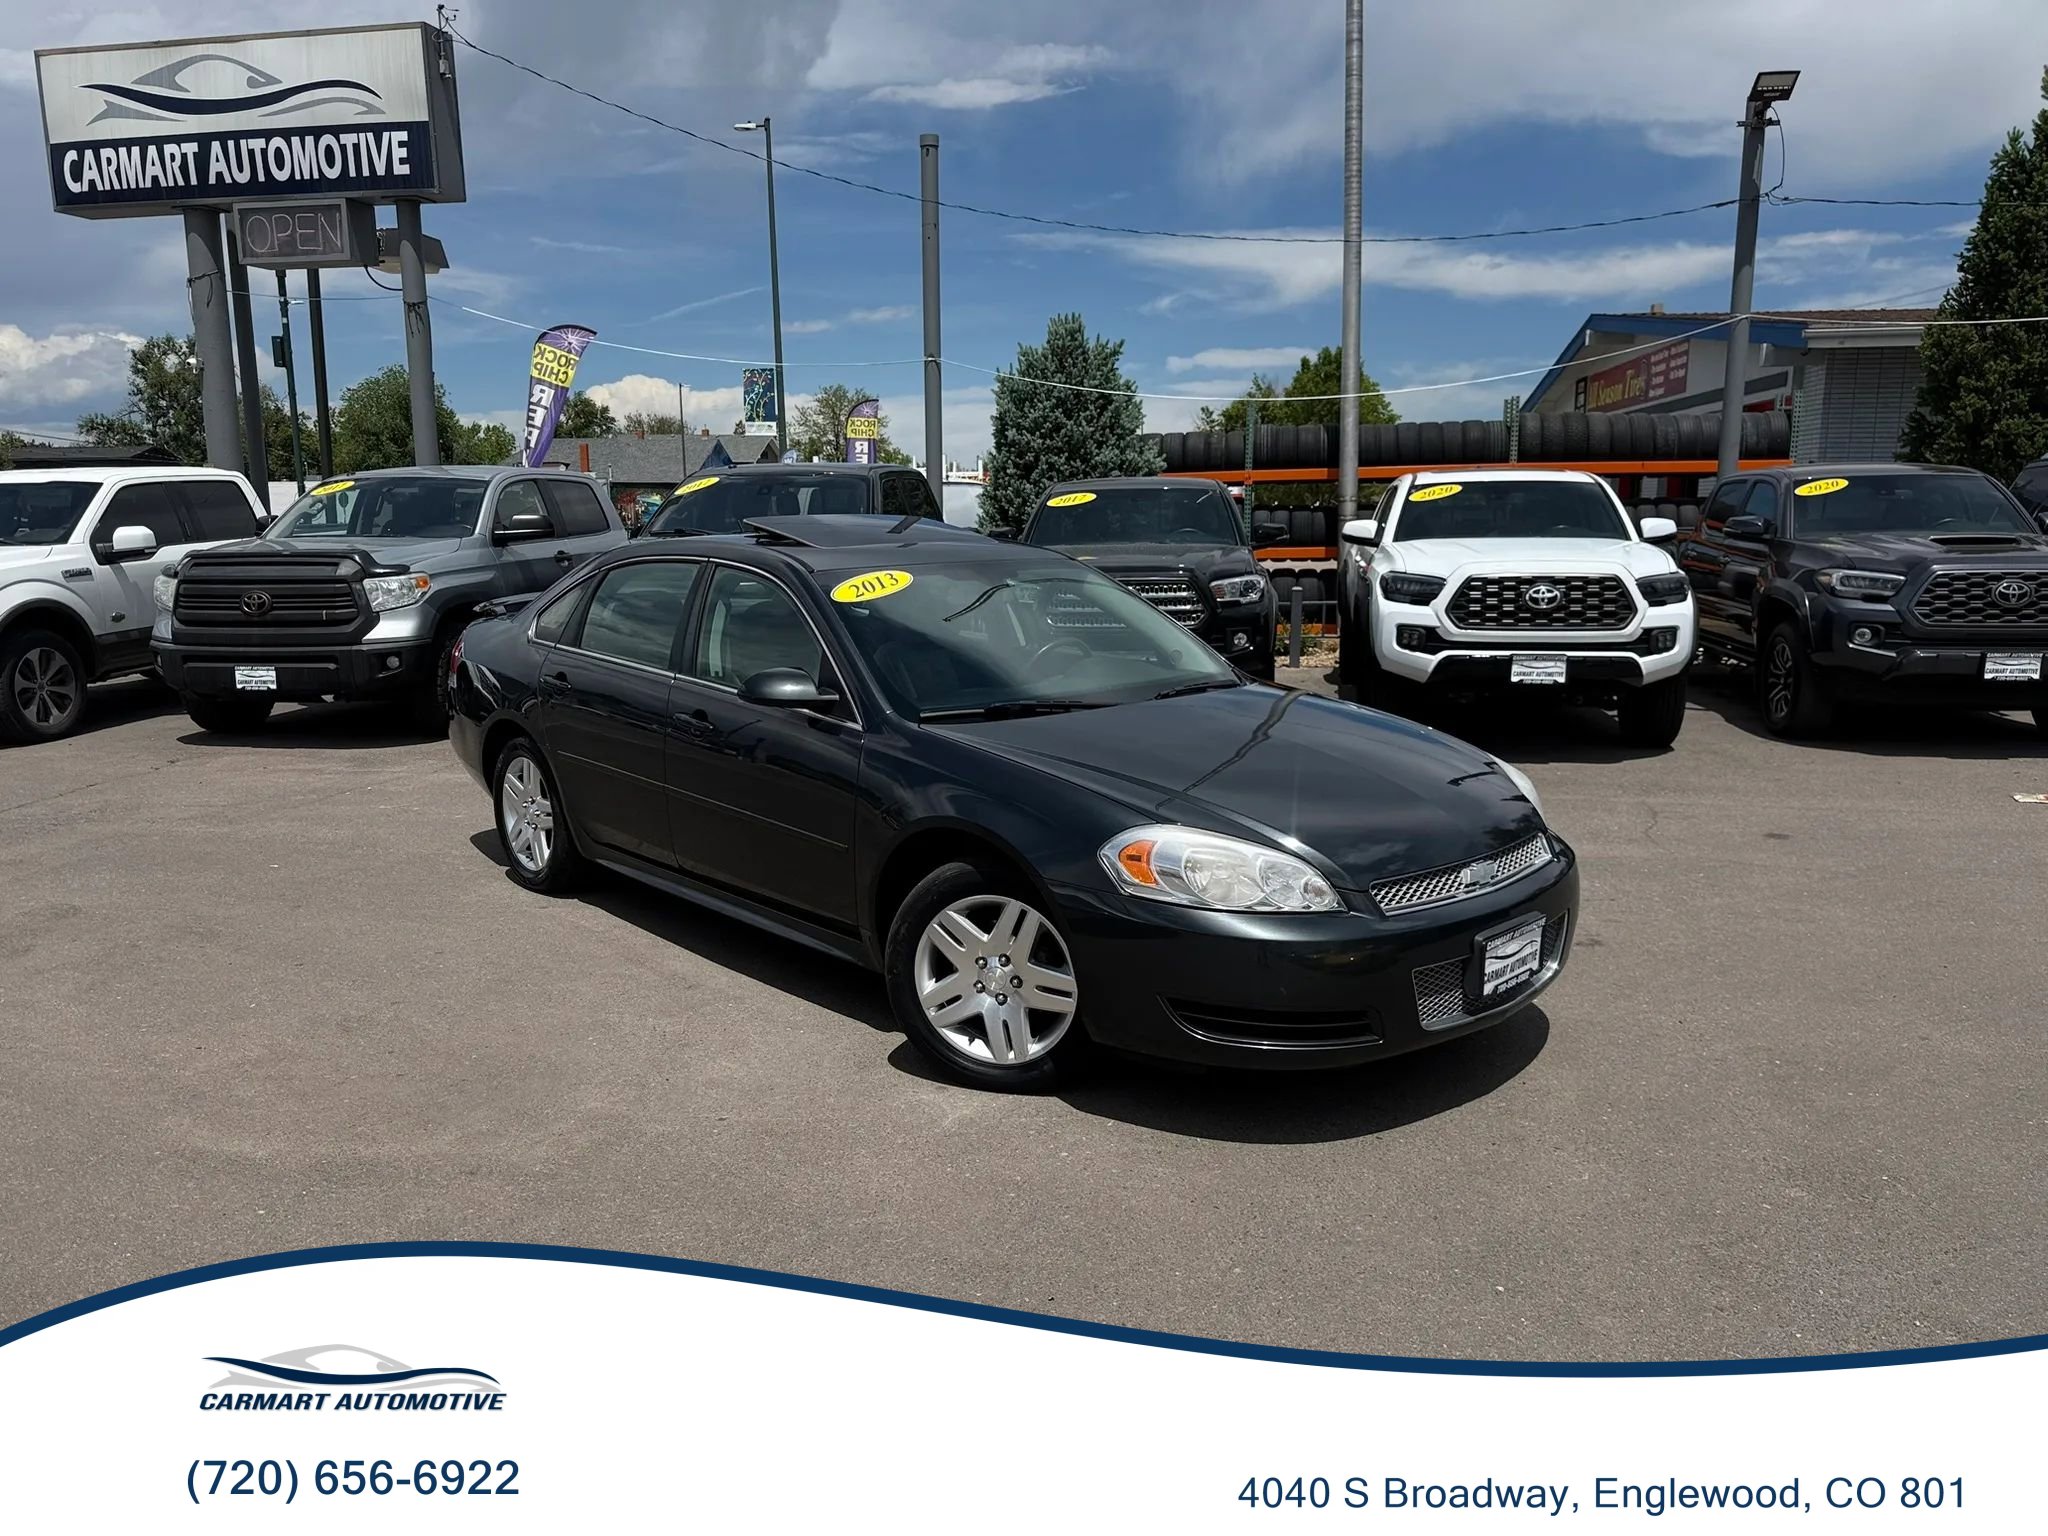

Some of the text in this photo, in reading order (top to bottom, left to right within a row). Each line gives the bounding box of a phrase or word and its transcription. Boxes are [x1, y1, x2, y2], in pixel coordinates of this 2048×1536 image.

[63, 131, 410, 193] CARMART AUTOMOTIVE
[246, 212, 342, 253] OPEN
[1420, 485, 1454, 499] 2020
[1807, 480, 1840, 494] 2020
[1055, 494, 1087, 505] 2017
[848, 572, 900, 598] 2013
[1487, 931, 1514, 950] CARMART
[1484, 963, 1510, 984] CARMART
[1509, 949, 1538, 975] AUTOMOTIVE
